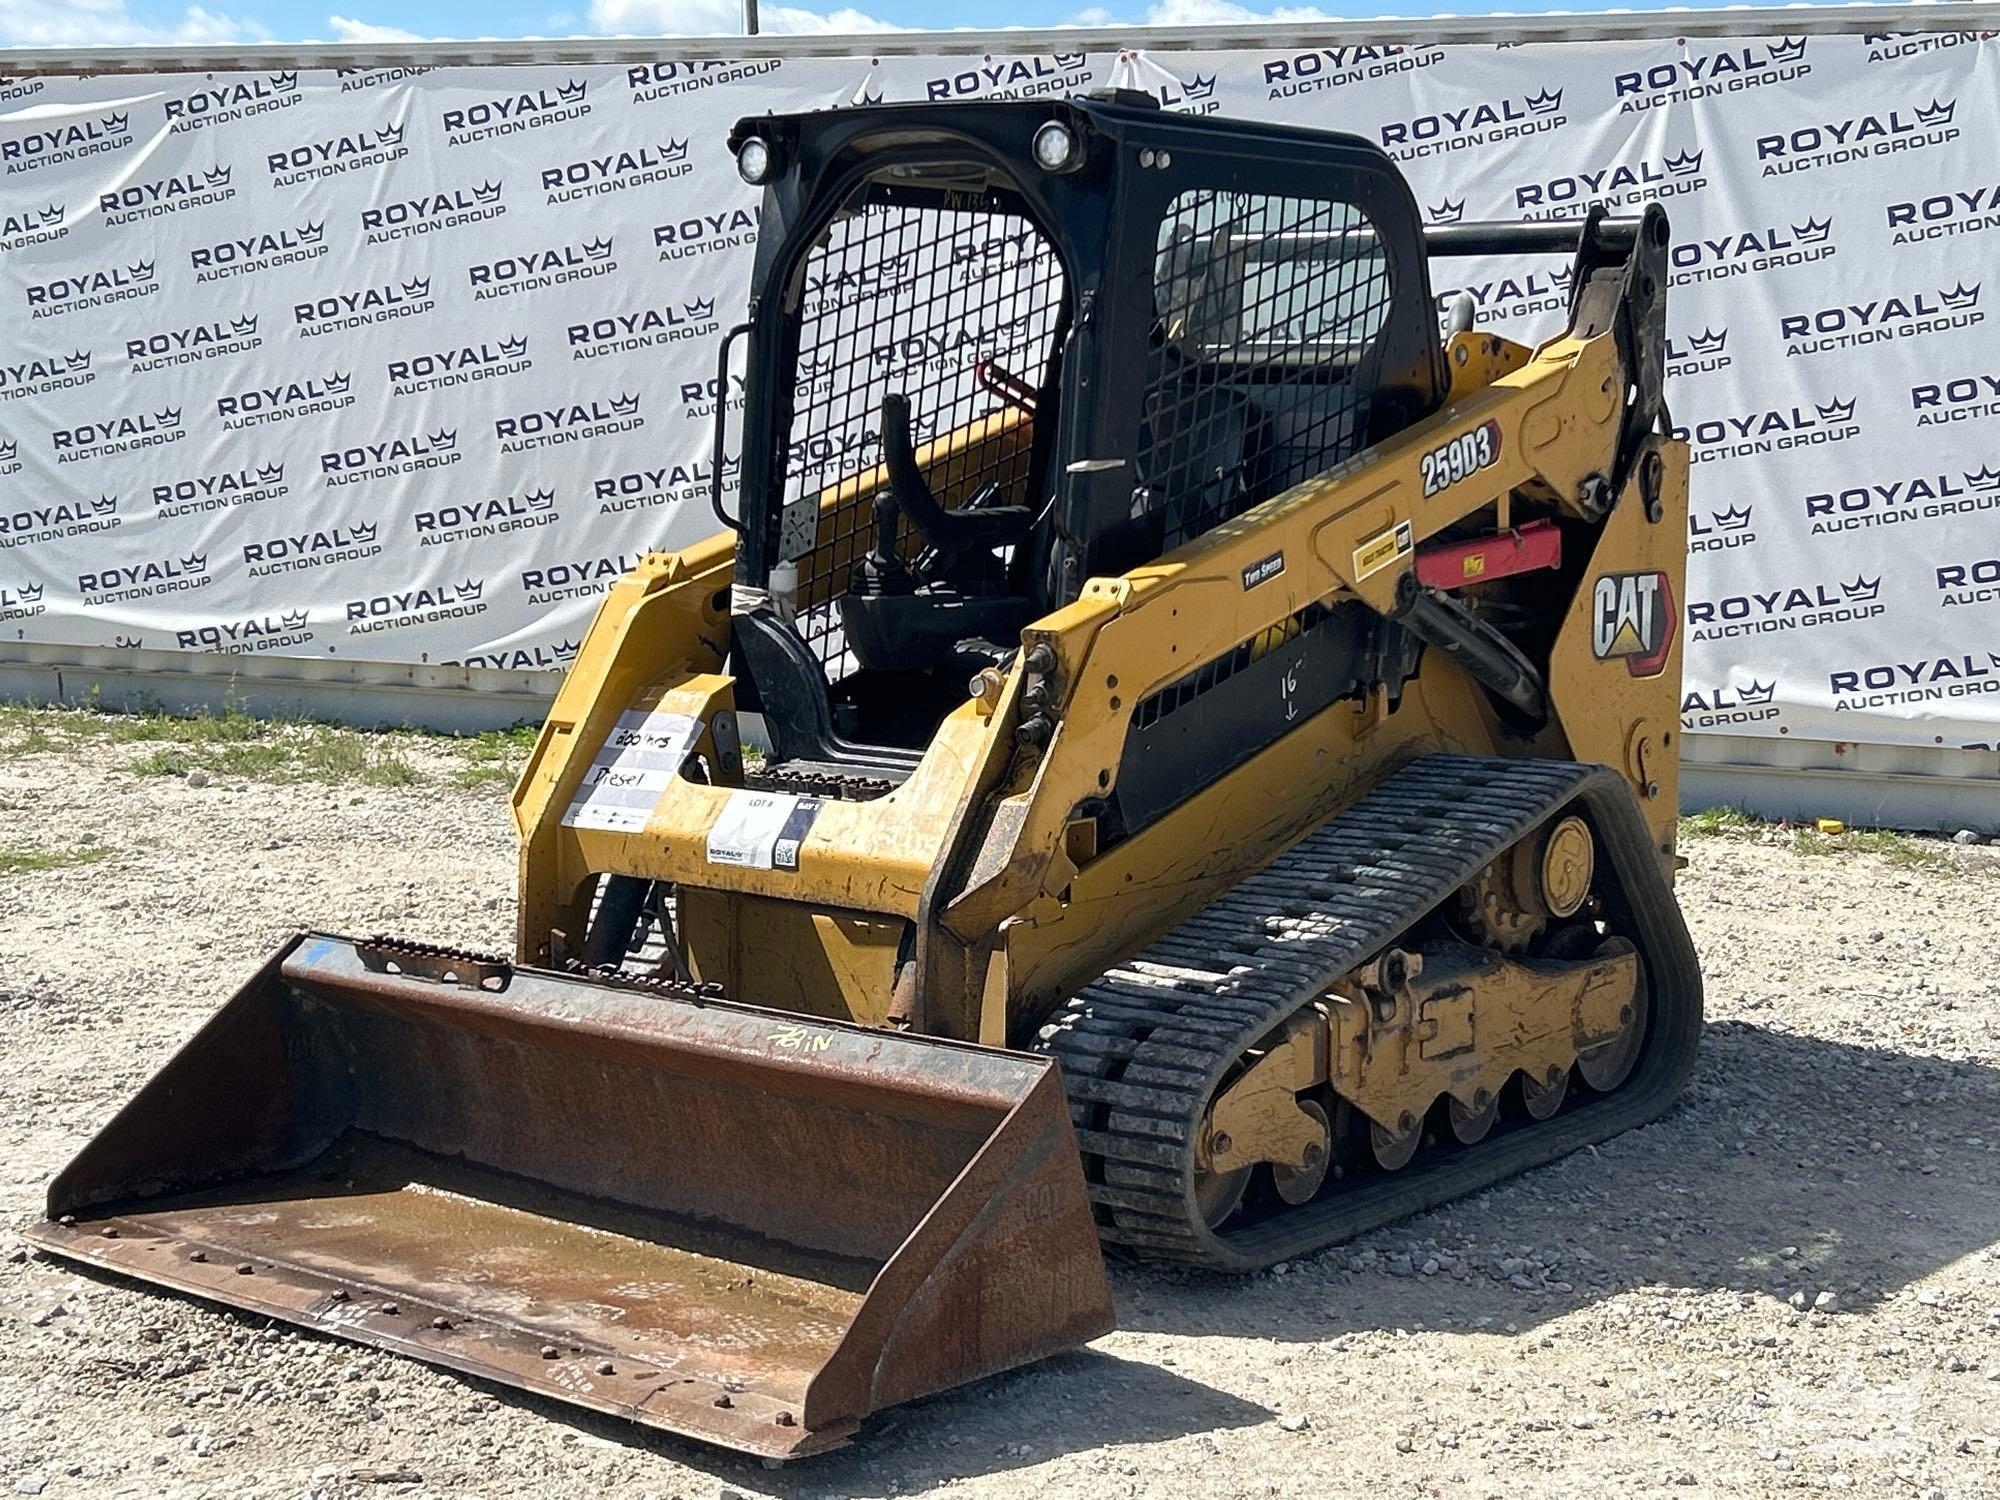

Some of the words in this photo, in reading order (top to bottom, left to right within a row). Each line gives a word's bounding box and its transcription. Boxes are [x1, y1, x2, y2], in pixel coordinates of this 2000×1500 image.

[1868, 32, 1977, 63] AUCTION
[341, 68, 416, 93] AUCTION
[633, 75, 713, 104] AUCTION
[717, 60, 781, 84] GROUP
[927, 57, 1055, 101] ROYAL
[1023, 72, 1092, 97] GROUP
[1269, 69, 1363, 101] AUCTION
[1368, 52, 1444, 78] GROUP
[1615, 48, 1767, 97] ROYAL
[1619, 81, 1722, 115] AUCTION
[1728, 65, 1811, 91] GROUP
[0, 82, 44, 101] ROUP
[164, 80, 271, 120] ROYAL
[169, 109, 242, 135] AUCTION
[245, 94, 302, 116] GROUP
[443, 90, 558, 132] ROYAL
[449, 120, 525, 147] AUCTION
[529, 105, 591, 128] GROUP
[1381, 100, 1525, 147] ROYAL
[1, 122, 103, 161] ROYAL
[268, 133, 376, 173] ROYAL
[1389, 133, 1483, 163] AUCTION
[1488, 116, 1567, 142] GROUP
[1757, 112, 1914, 160] ROYAL
[1762, 146, 1868, 178] AUCTION
[1874, 129, 1960, 155] GROUP
[7, 150, 75, 175] AUCTION
[78, 136, 133, 157] GROUP
[274, 162, 346, 188] AUCTION
[349, 148, 408, 170] GROUP
[542, 149, 658, 190] ROYAL
[100, 175, 205, 213] ROYAL
[547, 178, 625, 205] AUCTION
[630, 164, 692, 186] GROUP
[1515, 162, 1664, 208] ROYAL
[1626, 178, 1708, 204] GROUP
[106, 202, 176, 227] AUCTION
[179, 189, 235, 210] GROUP
[362, 191, 473, 230] ROYAL
[367, 219, 442, 245] AUCTION
[446, 206, 506, 227] GROUP
[15, 227, 69, 248] GROUP
[659, 235, 740, 261] AUCTION
[1671, 228, 1792, 267] OYAL
[1892, 214, 2000, 246] AUCTION
[191, 231, 297, 269] ROYAL
[197, 259, 268, 284] AUCTION
[272, 246, 328, 266] GROUP
[469, 247, 584, 286] ROYAL
[1667, 261, 1747, 288] UCTION
[1752, 246, 1836, 272] GROUP
[27, 269, 130, 305] ROYAL
[475, 276, 551, 301] AUCTION
[555, 262, 617, 284] GROUP
[32, 296, 101, 319] AUCTION
[104, 283, 159, 303] GROUP
[294, 286, 403, 323] ROYAL
[1781, 294, 1939, 339] ROYAL
[300, 314, 372, 338] AUCTION
[376, 301, 434, 322] GROUP
[568, 307, 685, 345] ROYAL
[1787, 328, 1893, 357] AUCTION
[1899, 312, 1984, 337] GROUP
[126, 323, 232, 359] ROYAL
[132, 350, 202, 374] AUCTION
[206, 338, 262, 358] GROUP
[573, 335, 652, 360] AUCTION
[656, 322, 719, 344] GROUP
[874, 326, 995, 366] ROYAL
[0, 358, 66, 386] YAL
[388, 345, 499, 382] ROYAL
[394, 373, 468, 397] AUCTION
[472, 360, 532, 380] GROUP
[1667, 357, 1732, 378] ROUP
[1, 386, 38, 401] TION
[41, 373, 96, 392] GROUP
[217, 381, 324, 416] ROYAL
[223, 408, 295, 431] AUCTION
[298, 396, 355, 416] GROUP
[496, 402, 611, 439] ROYAL
[1916, 401, 2000, 427] AUCTIO
[53, 415, 156, 449] ROYAL
[58, 442, 127, 464] AUCTION
[130, 430, 185, 449] GROUP
[501, 430, 578, 454] AUCTION
[582, 418, 644, 438] GROUP
[1688, 440, 1772, 465] UCTION
[1777, 425, 1861, 450] GROUP
[321, 437, 429, 473] ROYAL
[327, 464, 399, 487] AUCTION
[402, 453, 461, 472] GROUP
[1421, 425, 1492, 497] 259D3
[153, 471, 257, 505] ROYAL
[594, 463, 711, 499] ROYAL
[1806, 475, 1964, 518] ROYAL
[158, 497, 228, 519] AUCTION
[232, 486, 288, 505] GROUP
[415, 497, 526, 532] ROYAL
[599, 491, 678, 514] AUCTION
[67, 518, 121, 536] GROUP
[421, 524, 495, 547] AUCTION
[498, 513, 559, 532] GROUP
[1811, 508, 1918, 536] AUCTION
[244, 529, 351, 563] ROYAL
[249, 556, 321, 578] AUCTION
[324, 545, 381, 564] GROUP
[1687, 533, 1756, 555] ROUP
[79, 561, 181, 593] ROYAL
[522, 554, 636, 590] ROYAL
[84, 586, 153, 606] AUCTION
[156, 576, 211, 594] GROUP
[347, 587, 455, 621] ROYAL
[528, 582, 605, 605] AUCTION
[1687, 585, 1840, 625] ROYAL
[1941, 588, 2000, 607] AUCT
[176, 618, 281, 648] ROYAL
[350, 614, 424, 635] AUCTION
[427, 603, 487, 622] GROUP
[1593, 574, 1658, 658] CAT
[1692, 617, 1796, 642] AUCTION
[1801, 605, 1885, 626] GROUP
[257, 632, 313, 650] GROUP
[1830, 655, 1989, 694] ROYAL
[1834, 687, 1942, 711] AUCTION
[1947, 678, 2000, 698] GRO
[1699, 707, 1780, 728] GROUP
[593, 767, 645, 787] Diesel
[749, 799, 767, 808] LOT
